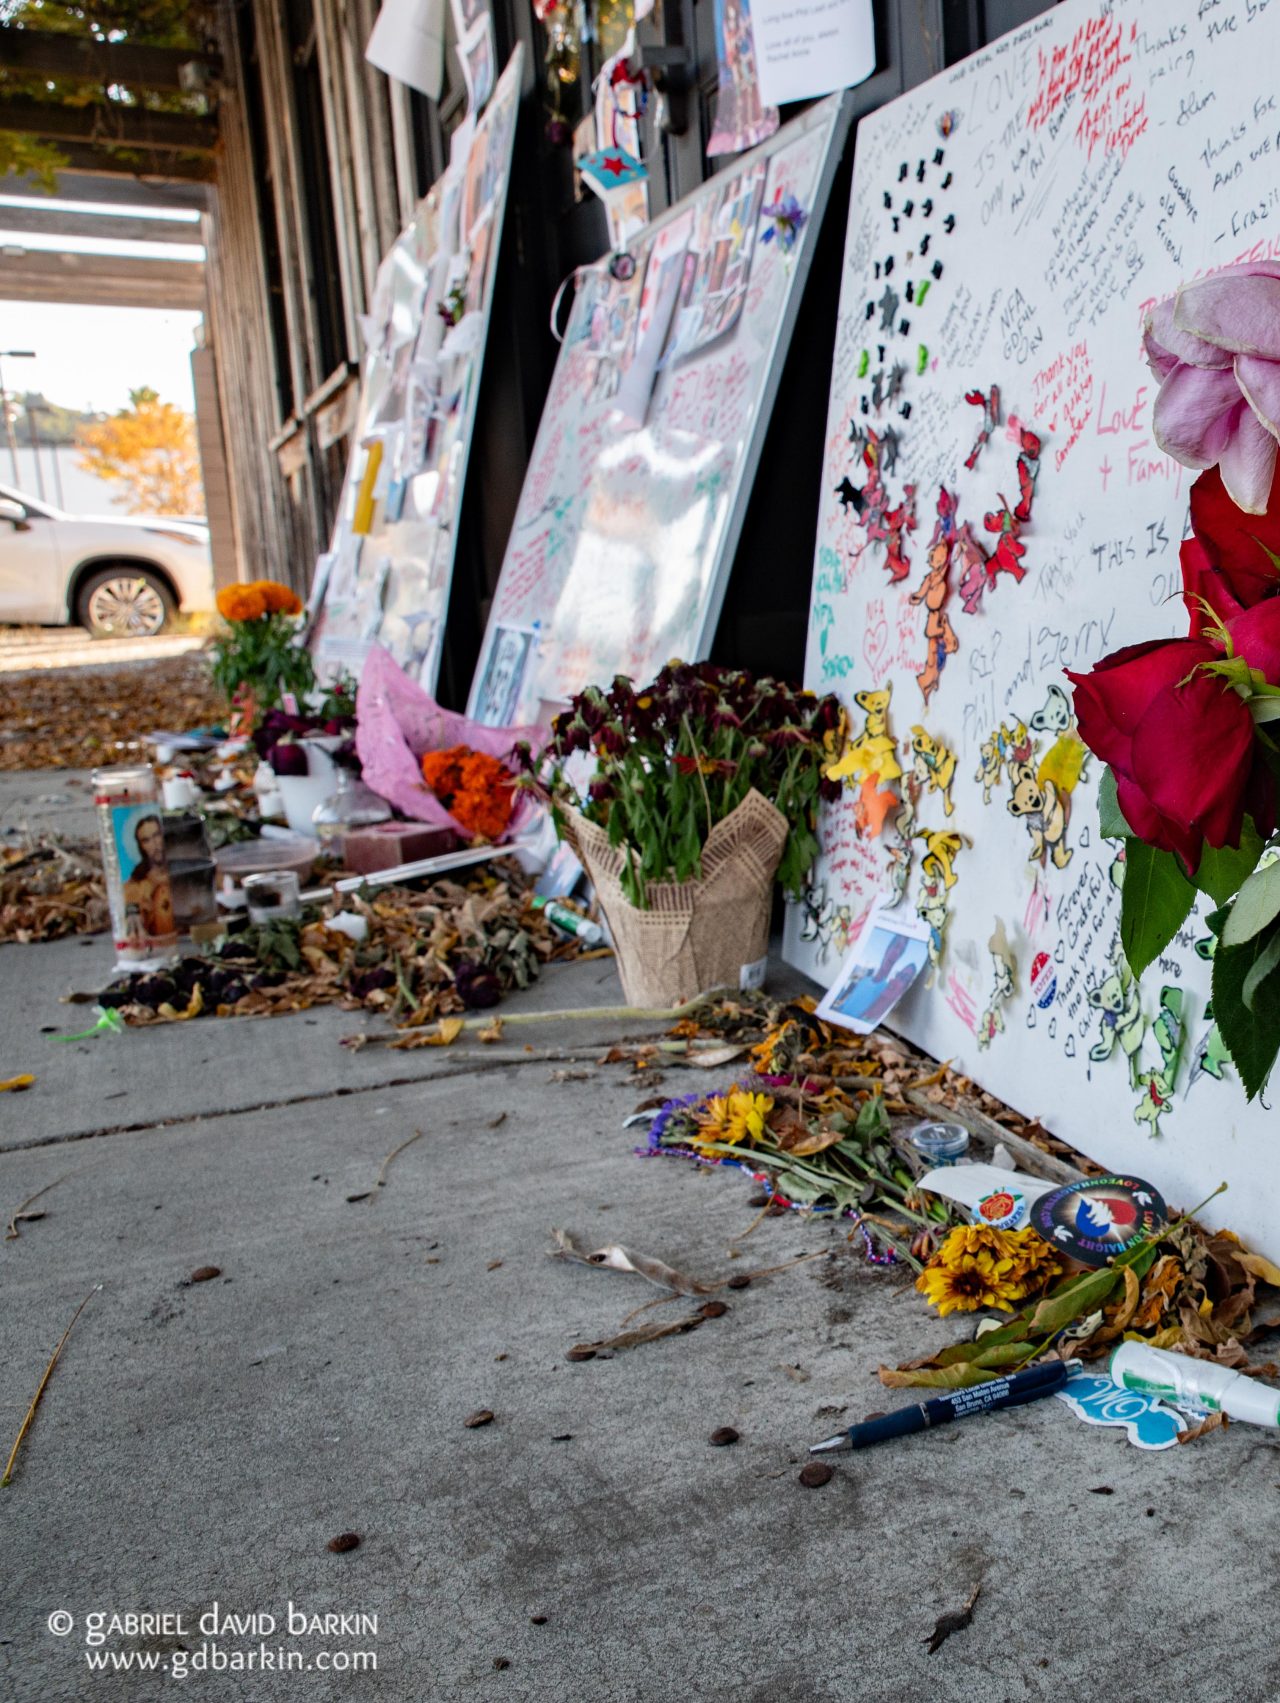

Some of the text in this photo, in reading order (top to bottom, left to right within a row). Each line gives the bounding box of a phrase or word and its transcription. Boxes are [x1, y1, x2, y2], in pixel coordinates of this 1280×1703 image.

[1168, 164, 1199, 224] Goodbye
[963, 678, 996, 760] Phil
[1056, 860, 1090, 932] Forever
[1066, 861, 1105, 950] Grateful
[1055, 964, 1081, 1009] Thank
[1077, 1238, 1128, 1255] HAIGHT
[951, 1396, 963, 1406] 453
